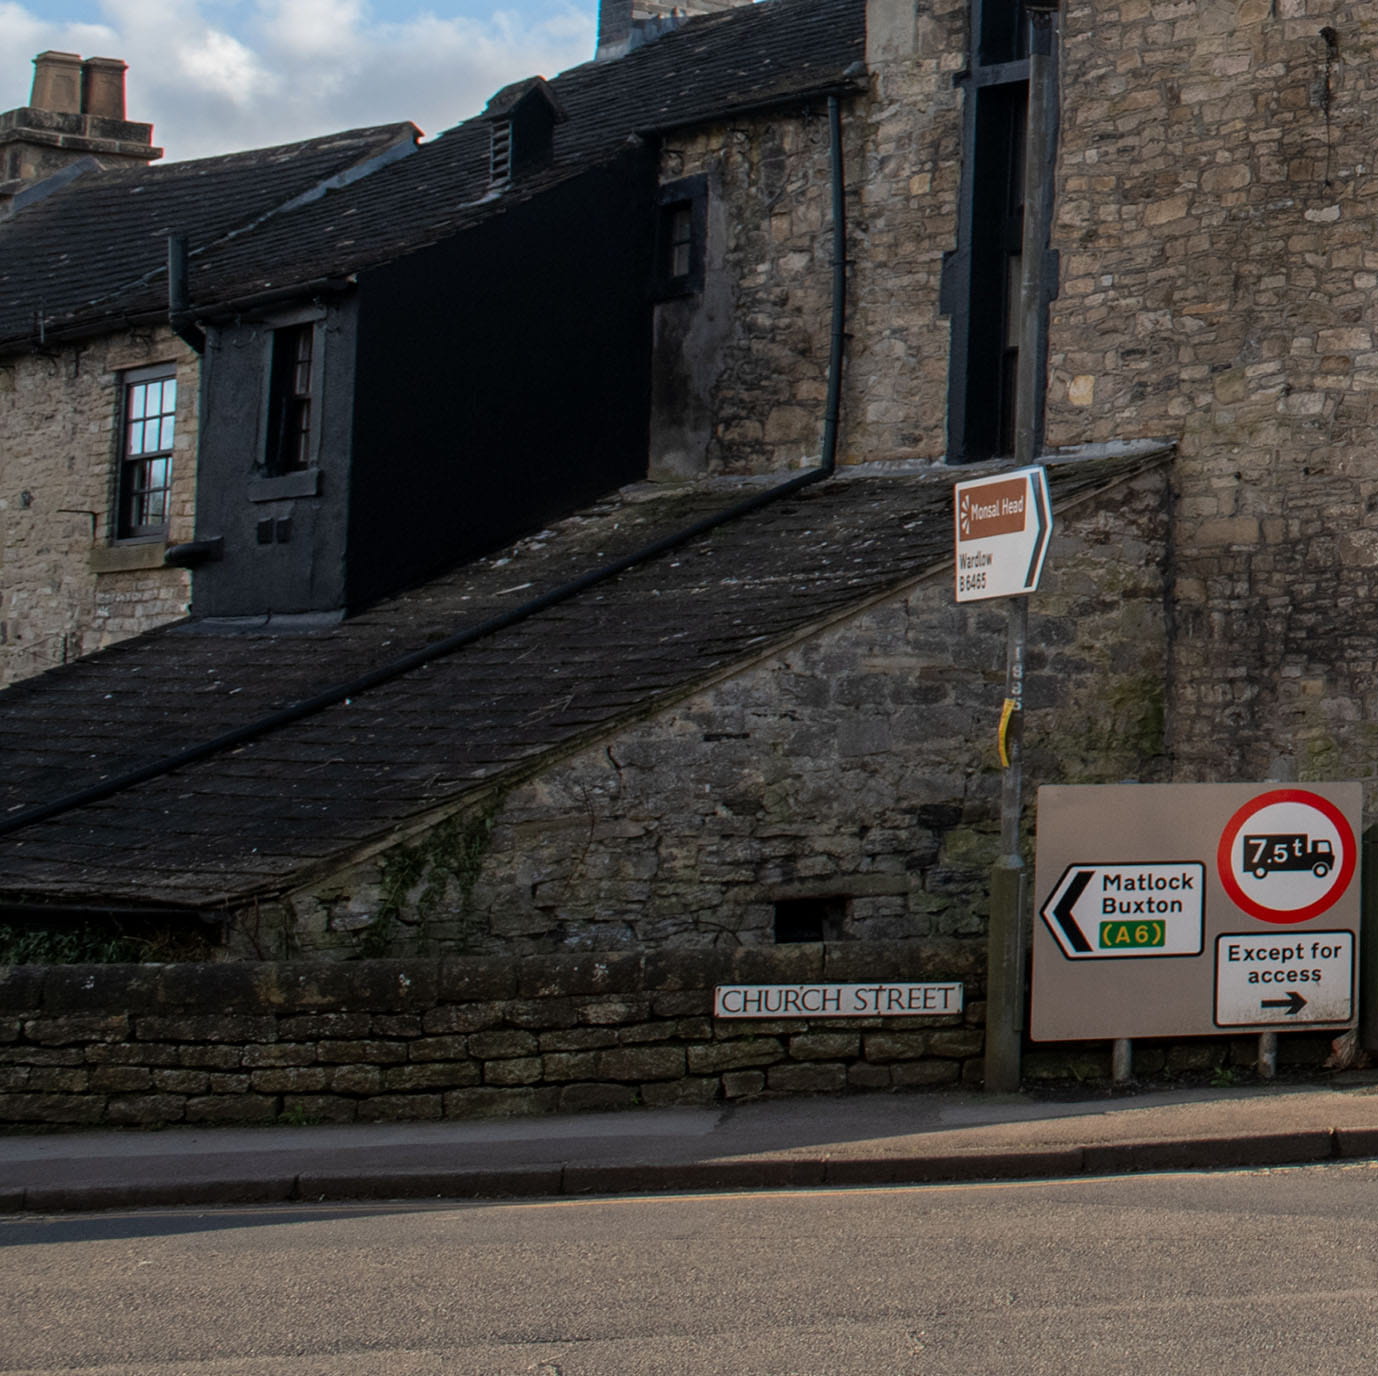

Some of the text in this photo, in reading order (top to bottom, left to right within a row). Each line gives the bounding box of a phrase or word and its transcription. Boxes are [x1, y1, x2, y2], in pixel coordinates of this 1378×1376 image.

[971, 495, 1024, 521] Monsal Head
[959, 550, 993, 570] Wardlow
[1249, 839, 1289, 864] 7.5
[1103, 873, 1194, 892] Matlock
[1102, 897, 1183, 915] Buxton
[1227, 942, 1342, 964] Except for
[1247, 968, 1323, 984] access
[721, 986, 956, 1013] CHURCH STREET
